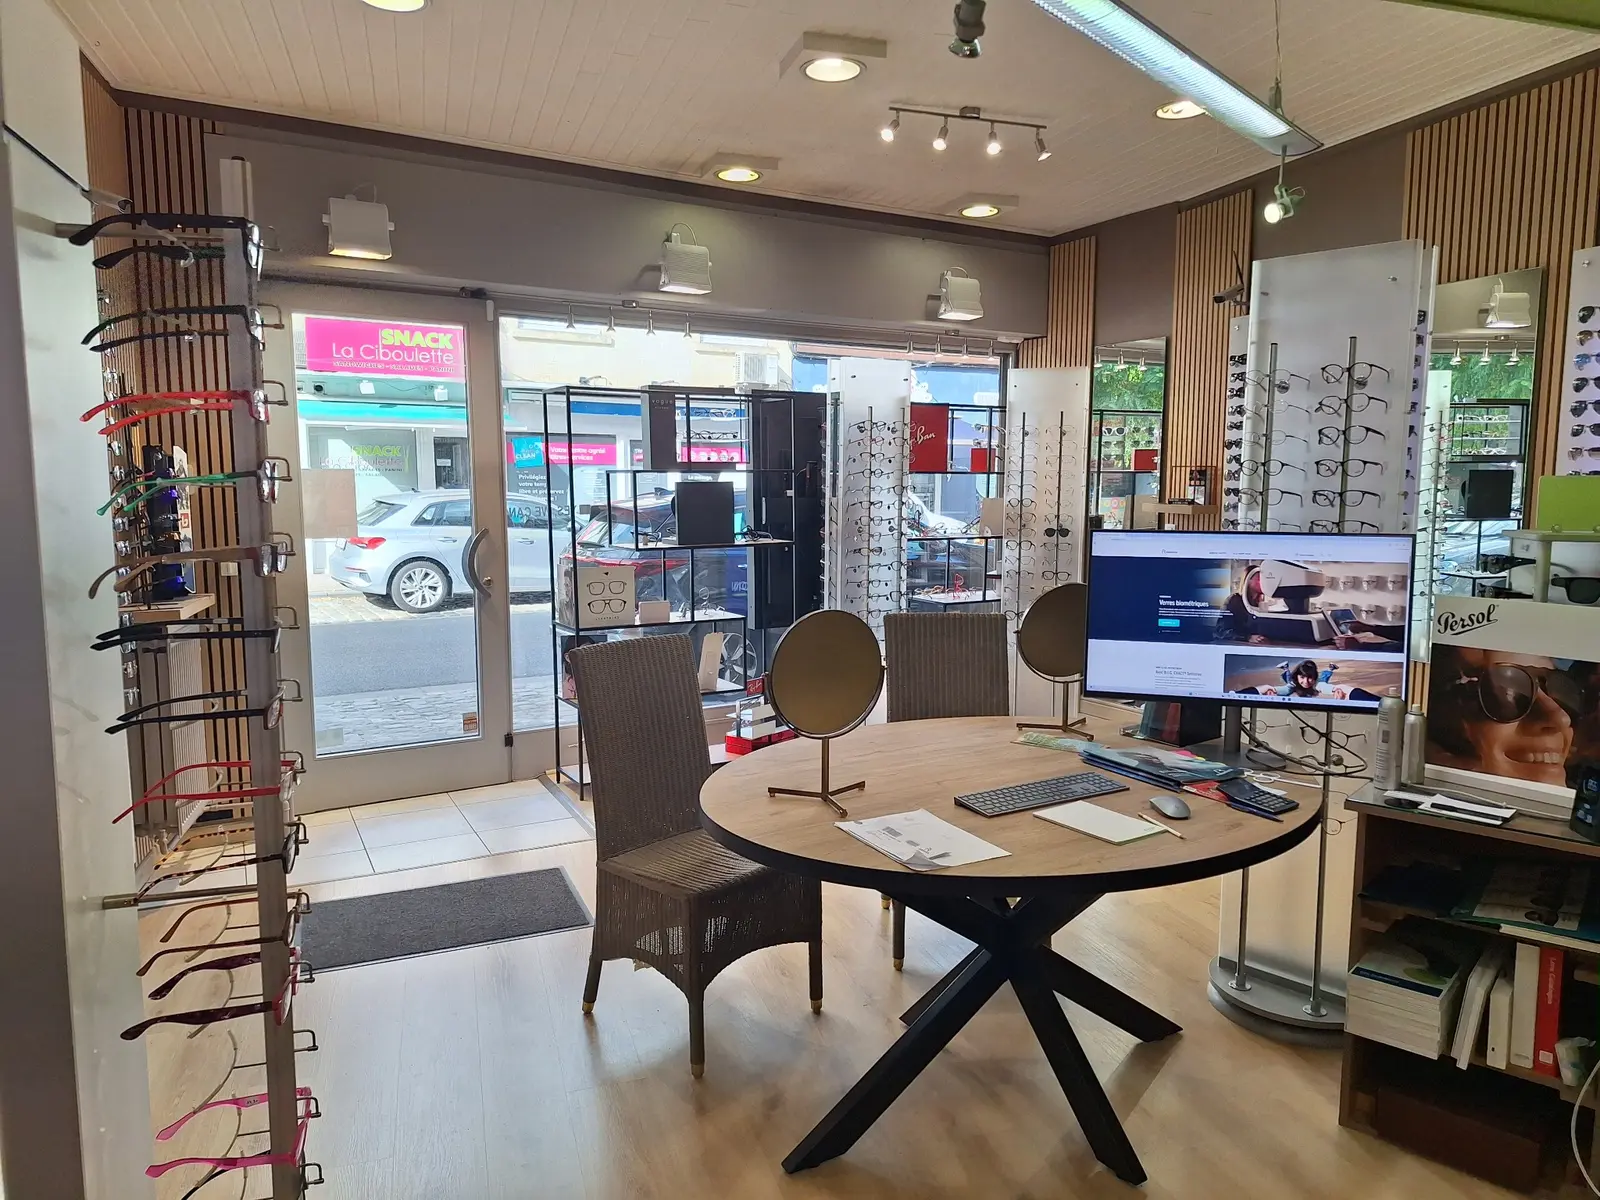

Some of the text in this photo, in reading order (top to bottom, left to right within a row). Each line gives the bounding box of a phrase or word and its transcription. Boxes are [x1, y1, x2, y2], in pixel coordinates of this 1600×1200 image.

[381, 328, 454, 350] SNACK
[332, 340, 454, 365] La Ciboulette
[351, 444, 402, 457] SNACK
[1175, 600, 1210, 608] biométriques
[1437, 603, 1499, 636] Persol
